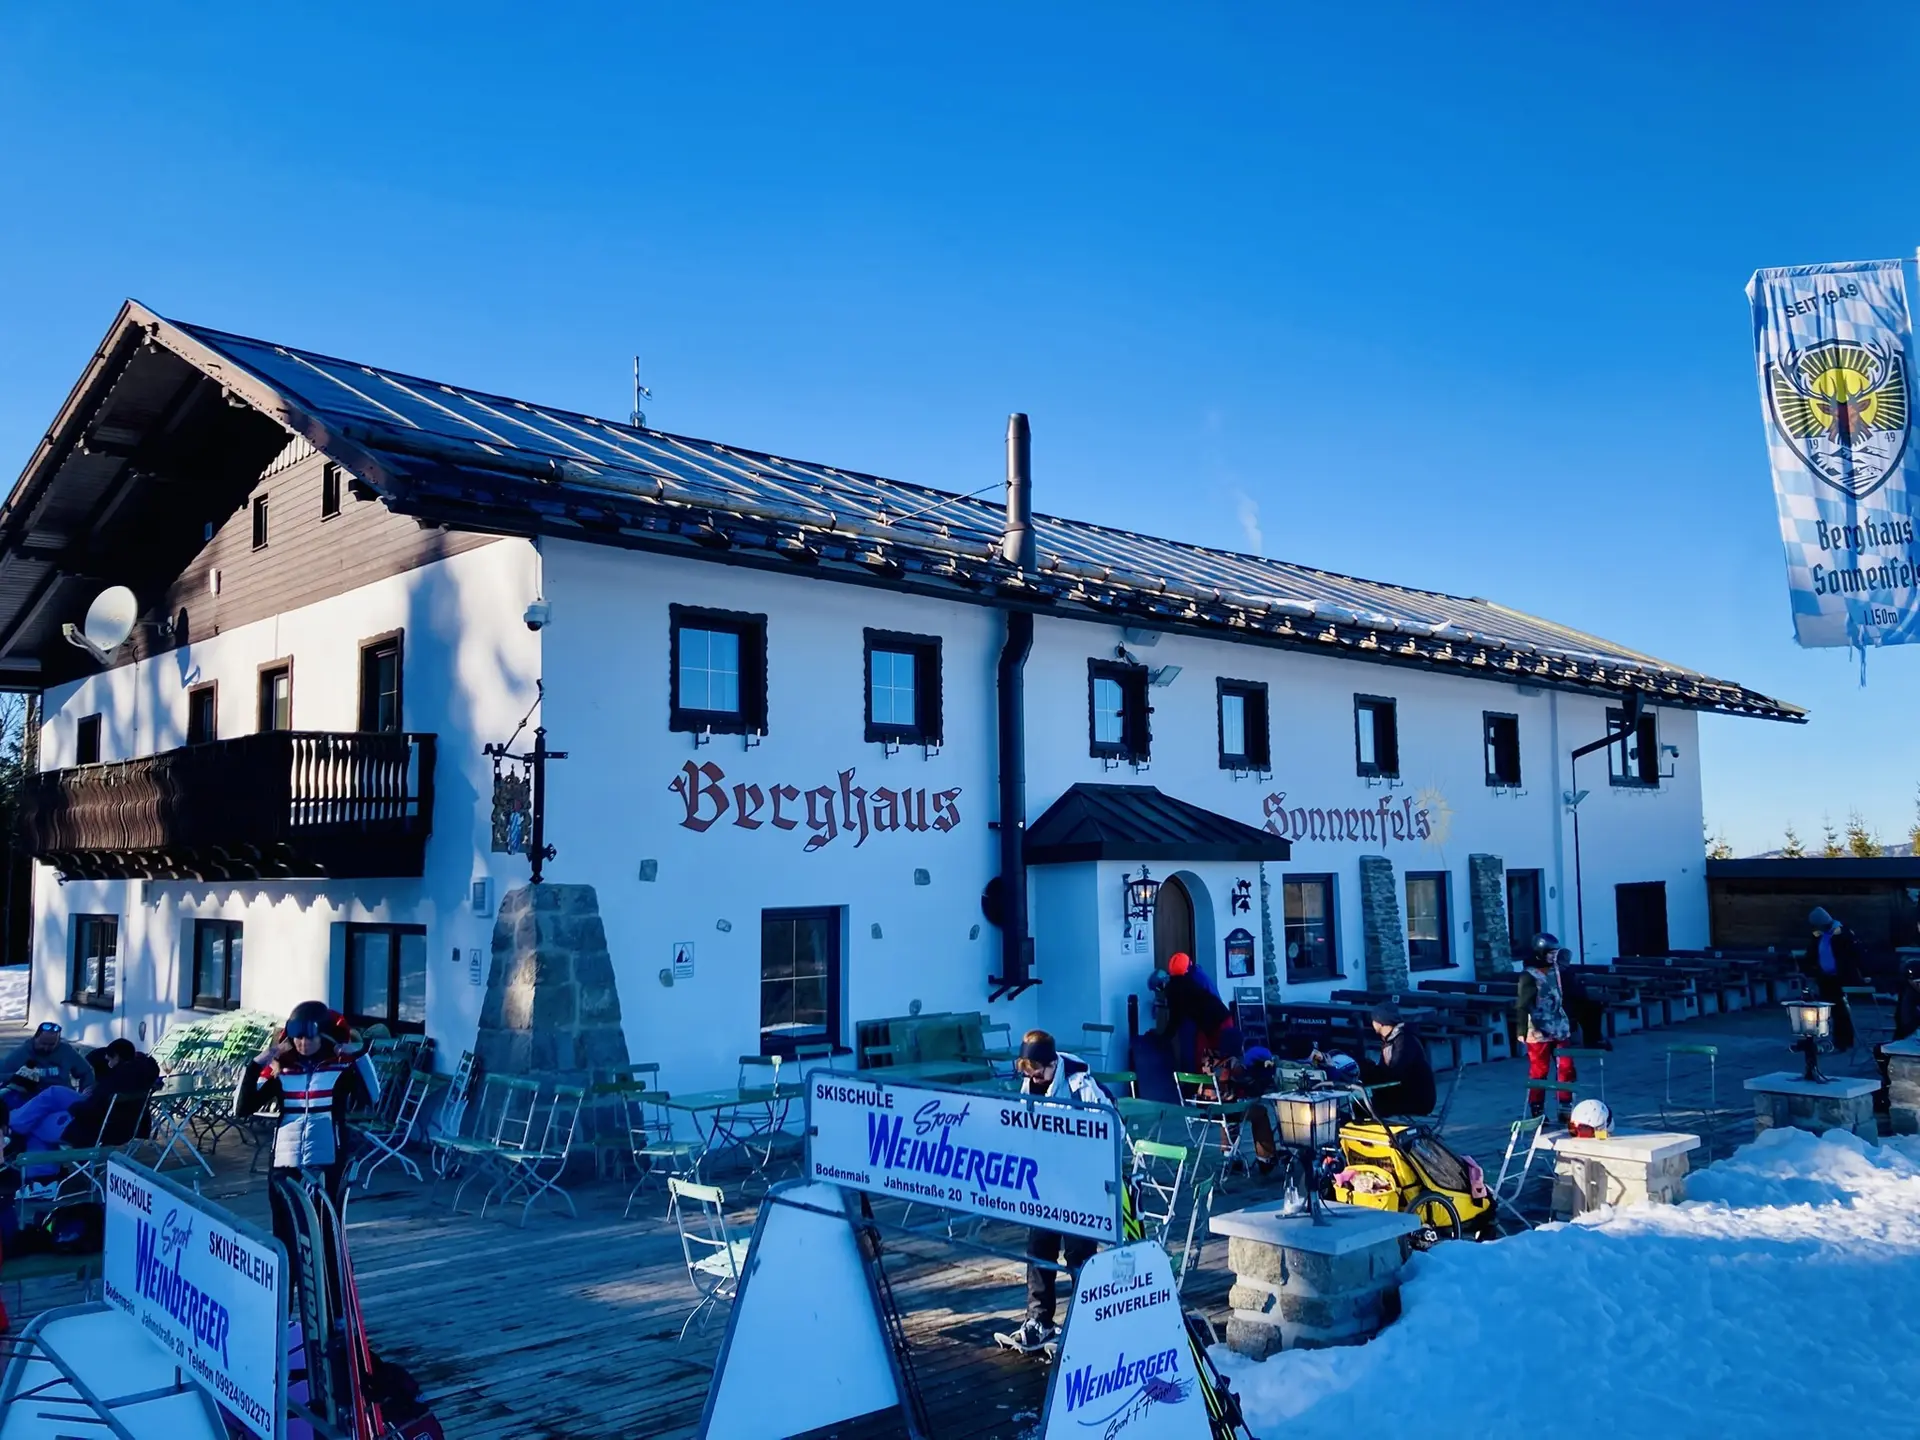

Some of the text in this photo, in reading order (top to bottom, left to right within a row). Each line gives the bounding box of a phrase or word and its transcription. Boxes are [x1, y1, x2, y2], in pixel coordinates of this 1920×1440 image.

[1785, 284, 1859, 318] SEIT 1949
[1808, 431, 1896, 450] 19 49
[1816, 516, 1913, 556] Berghaus
[667, 759, 962, 852] Berghaus
[1262, 791, 1431, 851] Sonnenfels
[816, 1084, 894, 1109] SKISCHULE
[913, 1099, 970, 1136] Sport
[1000, 1108, 1109, 1141] SKIVERLEIH
[108, 1171, 153, 1216] SKISCHULE
[815, 1162, 1113, 1232] Bodenmais Jahnstraße 20 Telefon 09924/902273
[161, 1208, 194, 1256] Sport
[208, 1230, 274, 1292] SKIVERLEIH
[1081, 1271, 1153, 1305] SKISCULE
[1094, 1289, 1171, 1322] SKIVERLEIH
[105, 1279, 136, 1317] Bodenmais
[175, 1339, 185, 1358] 20
[187, 1347, 214, 1383] Telefon
[215, 1372, 272, 1434] 09924/902273
